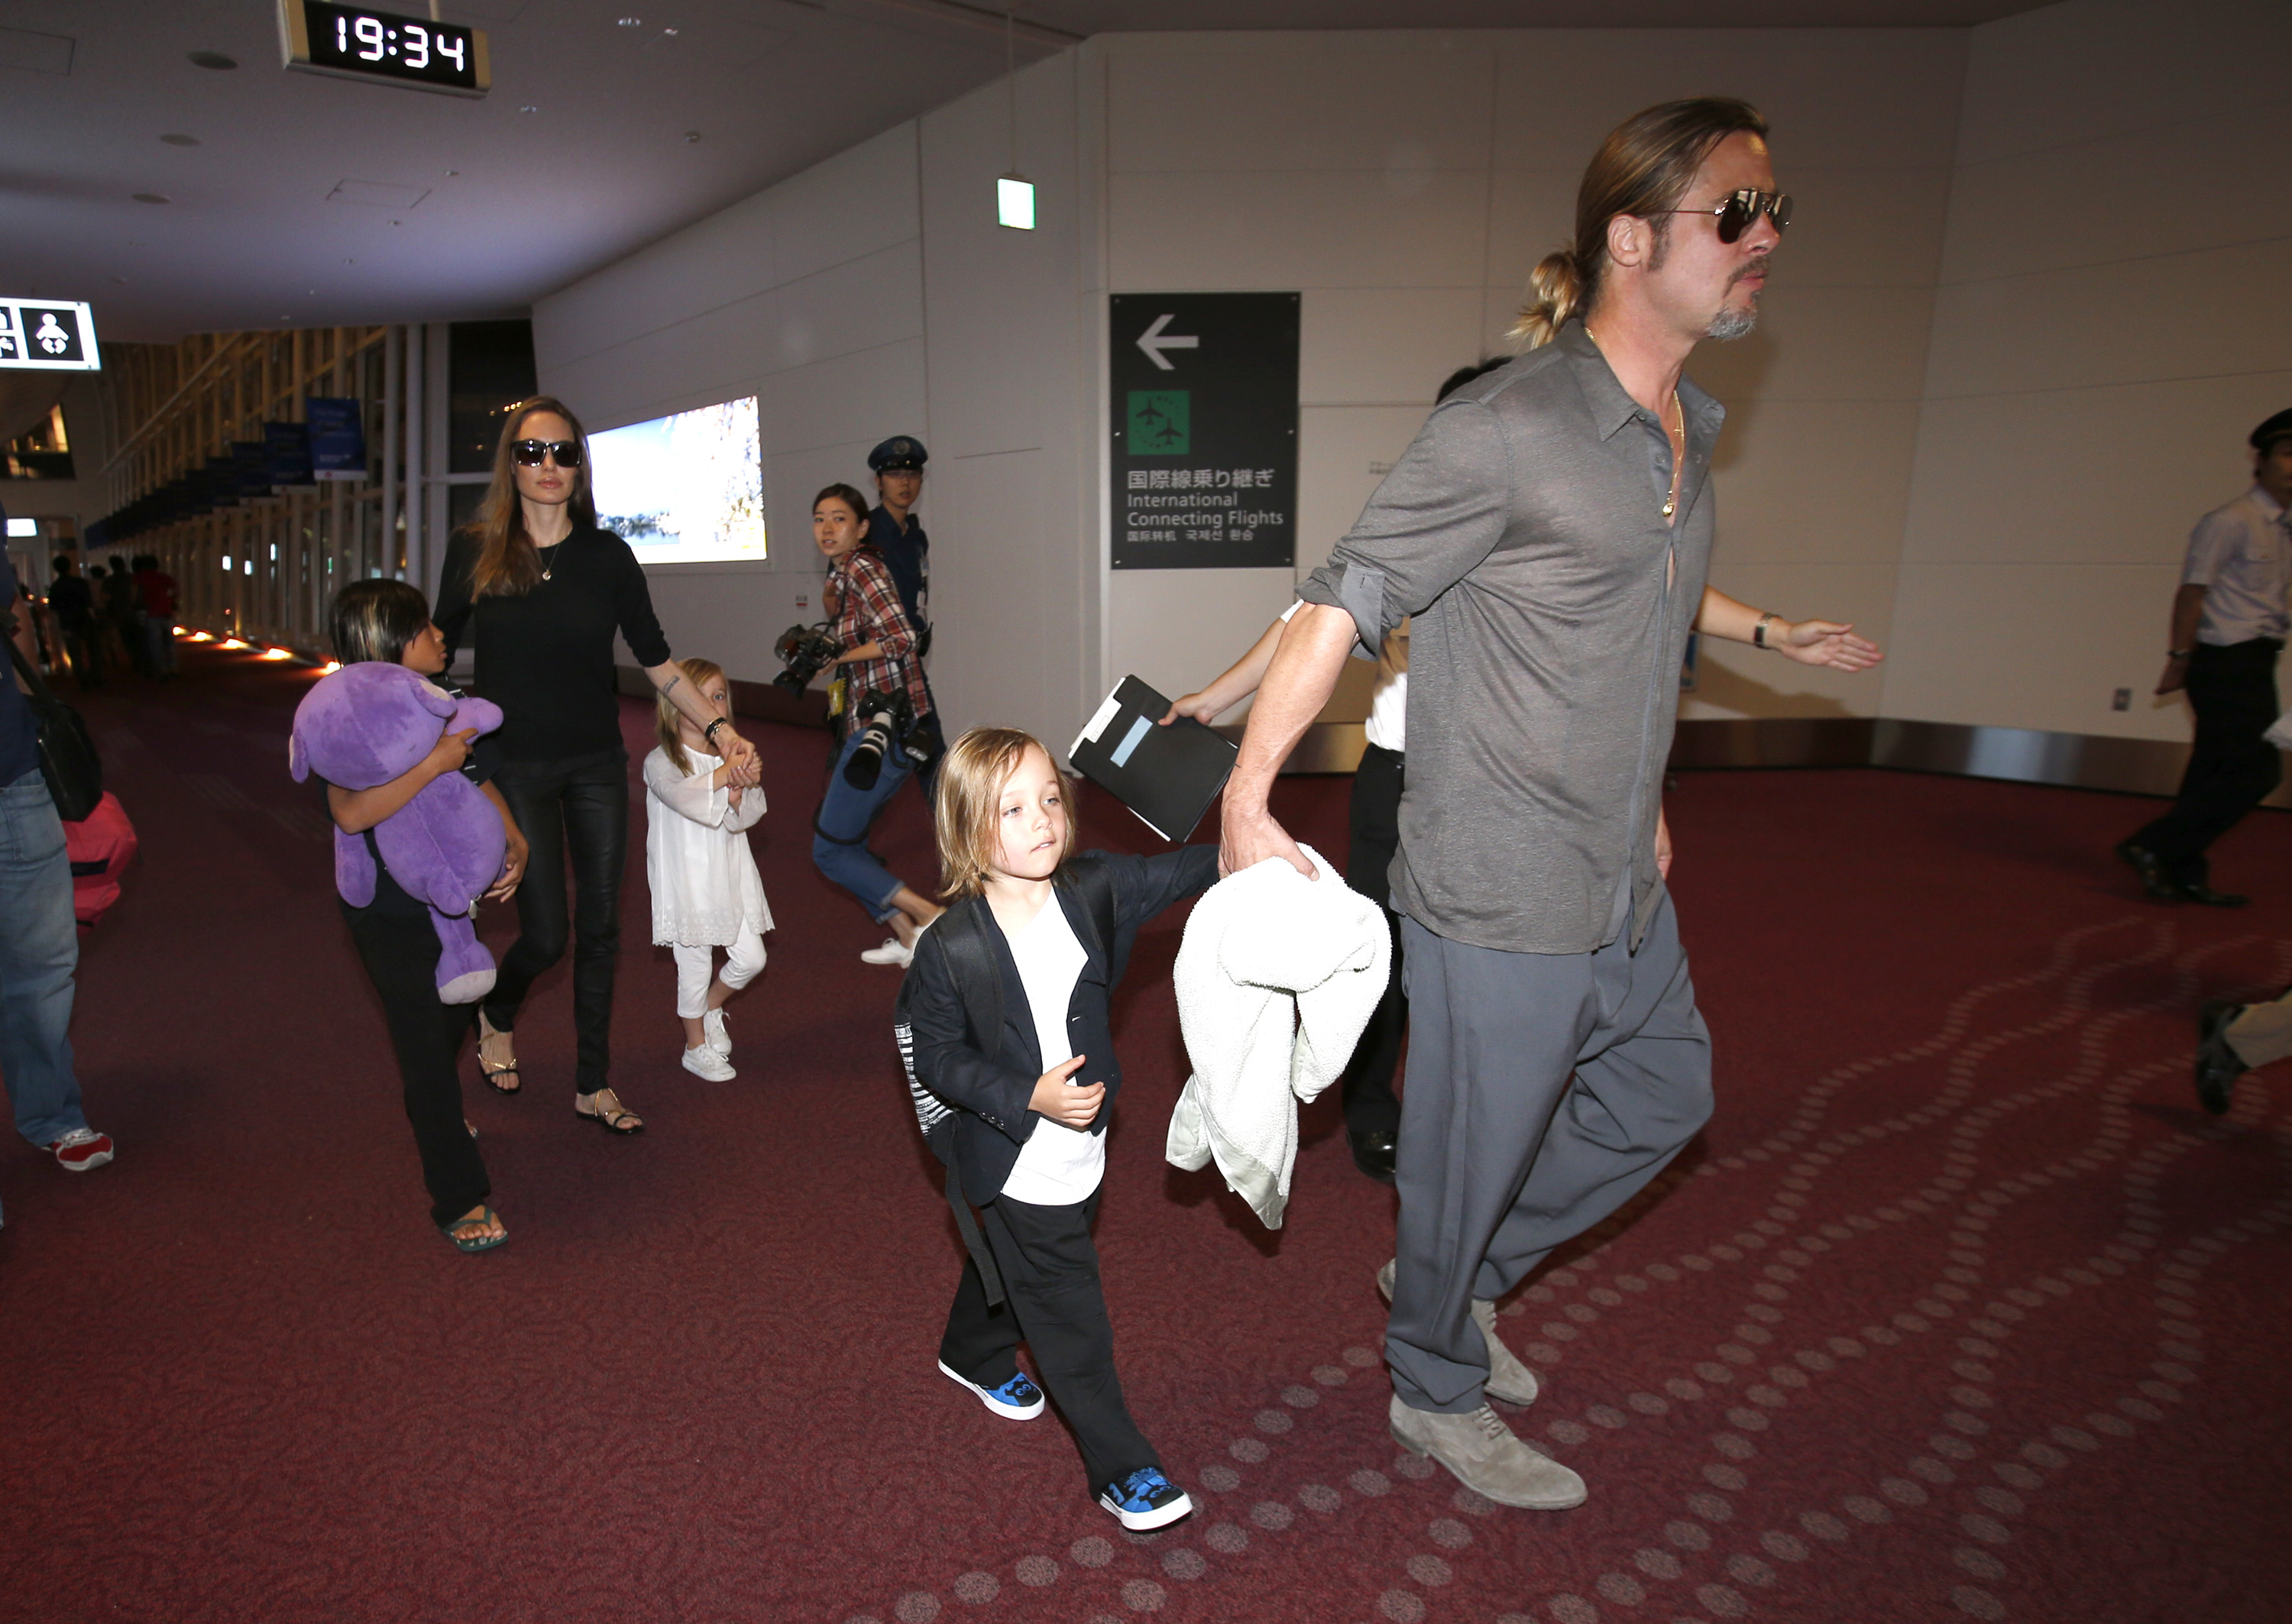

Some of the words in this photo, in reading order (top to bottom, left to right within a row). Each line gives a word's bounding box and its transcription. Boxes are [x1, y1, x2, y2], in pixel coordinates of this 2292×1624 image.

[338, 17, 464, 72] 19:34
[1127, 468, 1275, 489] 国際線乗り継ぎ
[1127, 491, 1238, 507] International
[1127, 511, 1223, 529] Connecting
[1228, 510, 1284, 529] Flights
